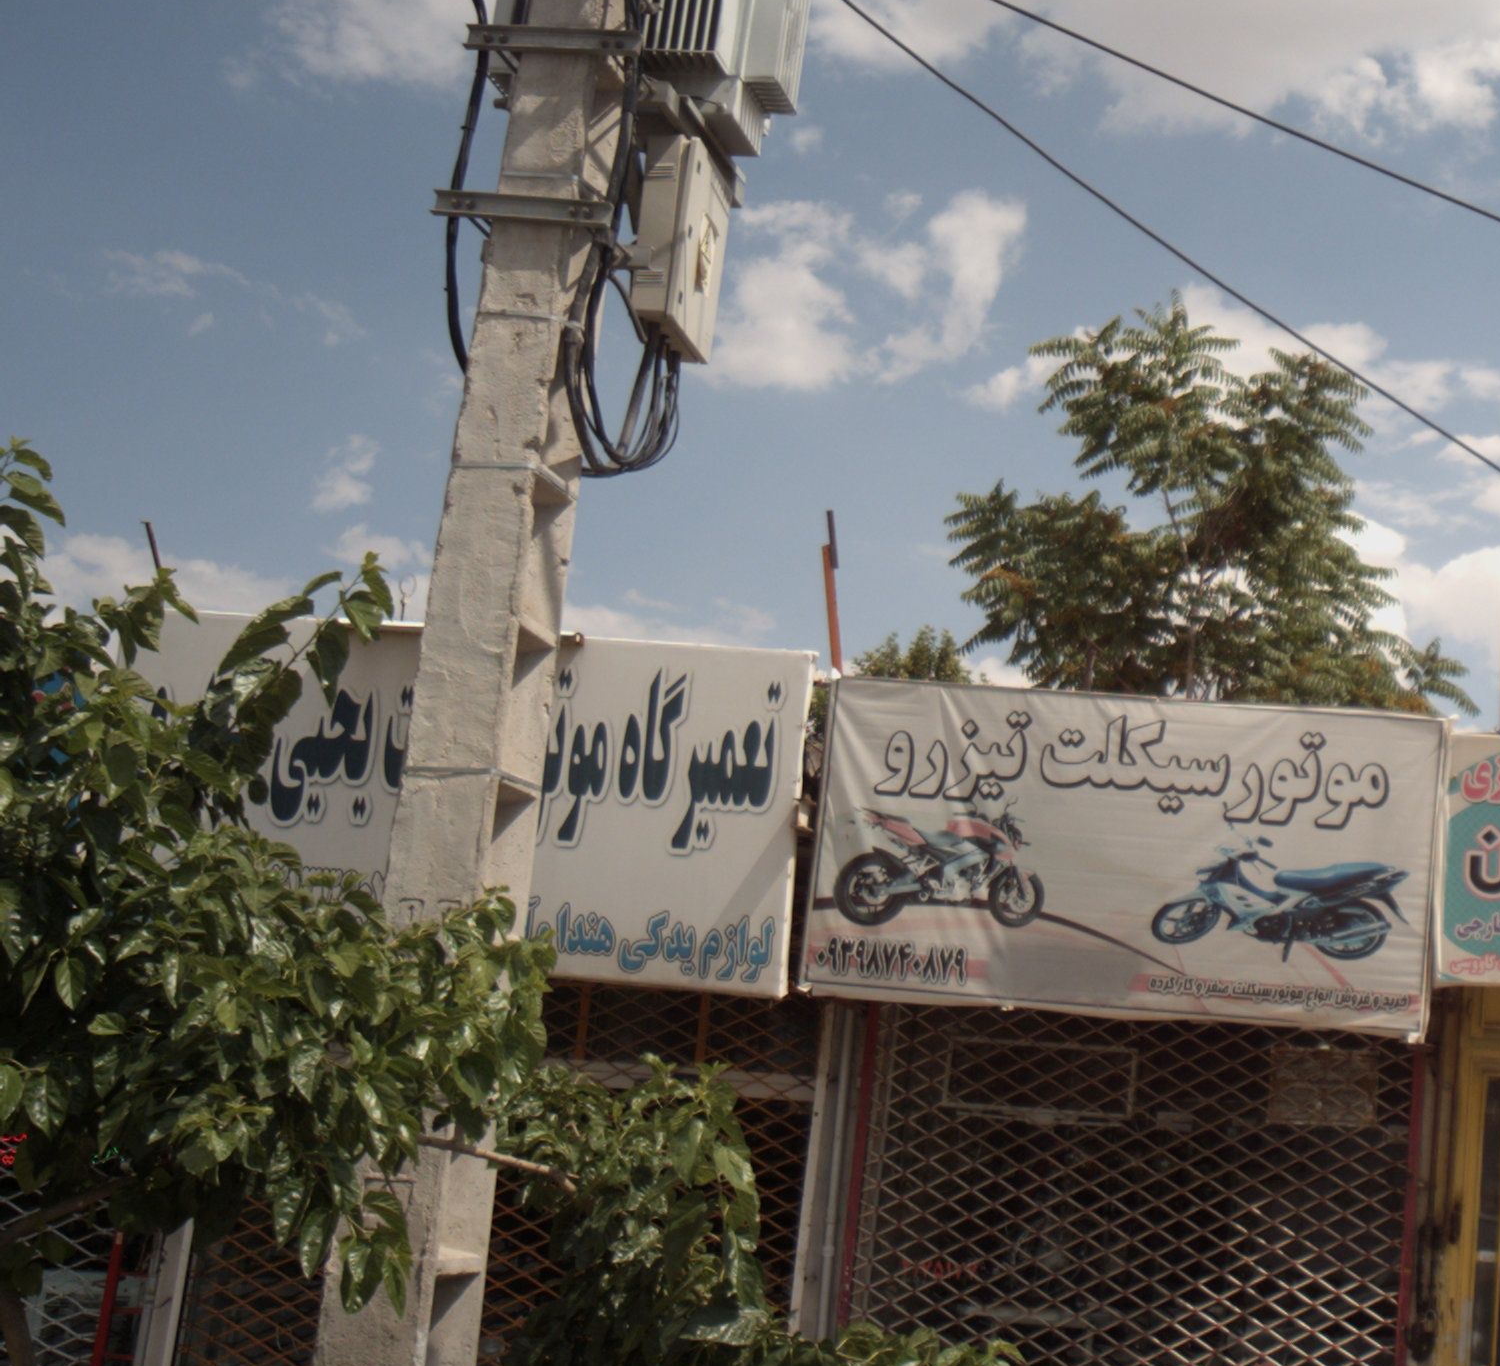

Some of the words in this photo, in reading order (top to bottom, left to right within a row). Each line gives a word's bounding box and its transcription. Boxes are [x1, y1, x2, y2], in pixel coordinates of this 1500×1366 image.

[873, 710, 1030, 802] تیزرو
[556, 901, 617, 956] هندا
[617, 909, 697, 976] یدکی
[699, 913, 775, 982] لوازم
[816, 936, 968, 984] ۰۹۳۹۸۷۴۰۸۷۹
[1204, 978, 1230, 996] صفر
[1305, 987, 1333, 1008] انواع
[1335, 988, 1372, 1007] فروش
[1382, 993, 1411, 1009] خرید
